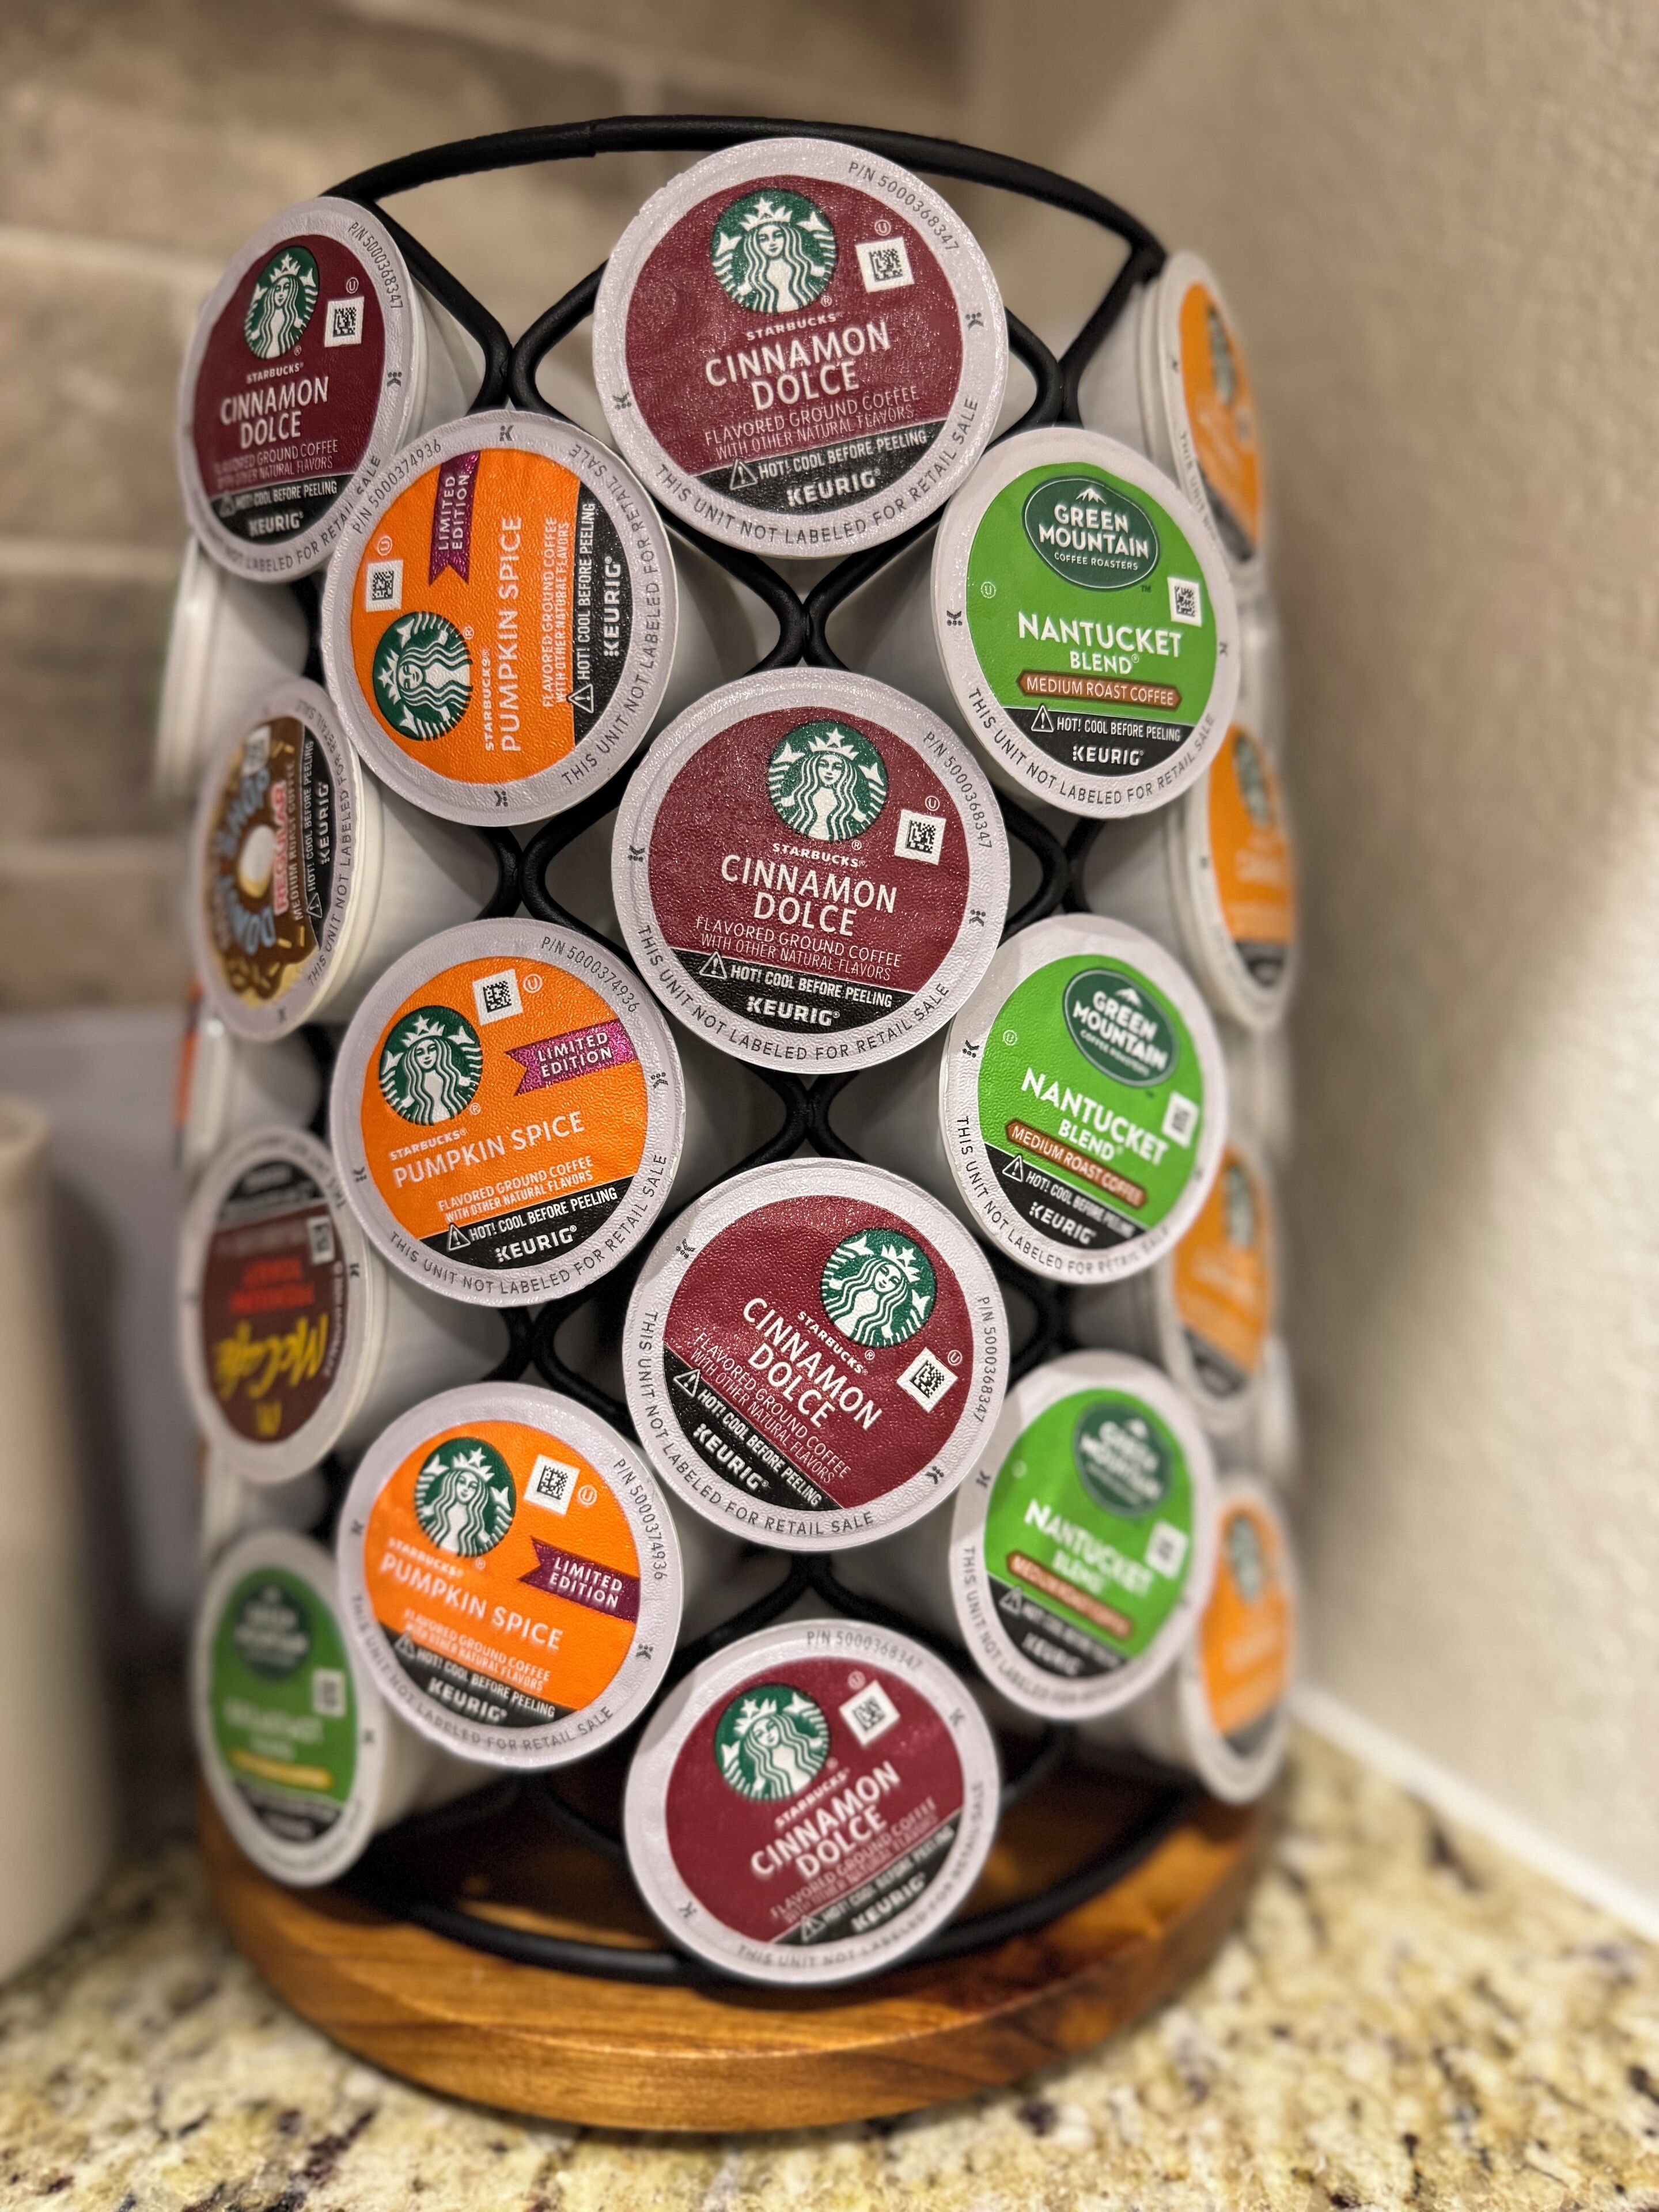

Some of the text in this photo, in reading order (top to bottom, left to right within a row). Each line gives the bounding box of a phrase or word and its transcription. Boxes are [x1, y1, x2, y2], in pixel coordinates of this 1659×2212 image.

[848, 161, 959, 252] P/N 5000368347
[347, 222, 403, 310] P/N 5000368347
[705, 321, 891, 387] CINNAMON
[752, 361, 860, 411] DOLCE
[221, 377, 329, 426] CINNAMON
[240, 412, 301, 449] DOLCE
[705, 386, 919, 447] FLAVORED GROUND COFFEE
[259, 440, 338, 465] GROUND COFFEE
[656, 397, 978, 545] THIS UNIT NOT LABELED FOR RETAIL SALE
[758, 430, 927, 480] HOT! COOL BEFORE PEELING
[274, 486, 301, 502] BEFORE
[304, 480, 337, 498] PEELING
[353, 440, 441, 533] P/N 5000374936
[438, 476, 455, 550] LIMITED
[452, 475, 470, 550] EDITION
[1054, 504, 1128, 533] GREEN
[1039, 525, 1149, 559] MOUNTAIN
[1054, 552, 1138, 570] COFFEE ROASTERS
[577, 503, 596, 680] HOT! COOL BEFORE PEELING
[498, 517, 522, 752] PUMPKIN SPICE
[1018, 610, 1181, 657] NANTUCKET
[1027, 676, 1173, 705] MEDIUM ROAST COFFEE
[968, 688, 1215, 804] THIS UNIT NOT LABELED FOR RETAIL SALE
[1056, 718, 1181, 741] HOT! COOL BEFORE PEELING
[303, 741, 313, 786] PEELING
[923, 732, 993, 849] P/N 5000368347
[722, 855, 897, 914] CINNAMON
[753, 892, 858, 937] DOLCE
[541, 936, 640, 1013] P/N 5000374936
[696, 916, 902, 968] FLAVORED GROUND COFFEE
[702, 933, 891, 981] WITH OTHER NATURAL FLAVORS
[637, 925, 949, 1060] THIS UNIT NOT LABELED FOR RETAIL SALE
[731, 964, 893, 1008] HOT! COOL BEFORE PEELING
[1093, 991, 1157, 1039] GREEN
[537, 1032, 608, 1061] LIMITED
[542, 1046, 612, 1079] EDITION
[1073, 1002, 1168, 1070] MOUNTAIN
[395, 1111, 586, 1189] PUMPKIN SPICE
[1021, 1067, 1170, 1166] NANTUCKET
[956, 1116, 988, 1196] THIS UNIT
[1012, 1125, 1143, 1206] MEDIUM ROAST COFFEE
[391, 1154, 667, 1294] THIS UNIT NOT LABELED FOR RETAIL SALE
[469, 1187, 618, 1241] HOT! COOL BEFORE PEELING
[743, 1297, 882, 1431] CINNAMON
[748, 1344, 836, 1429] DOLCE
[974, 1297, 997, 1423] P/N 5000368347
[638, 1312, 873, 1535] THIS UNIT NOT LABELED FOR RETAIL SALE
[696, 1332, 851, 1479] FLAVORED GROUND COFFEE
[698, 1391, 821, 1506] HOT! COOL BEFORE PEELING
[613, 1459, 668, 1581] P/N 5000374936
[380, 1553, 563, 1650] PUMPKIN SPICE
[550, 1571, 619, 1609] EDITION
[554, 1556, 623, 1592] LIMITED
[806, 1631, 831, 1646] P/N
[471, 1675, 555, 1718] BEFORE PEELING
[751, 1761, 901, 1877] CINNAMON
[794, 1804, 887, 1880] DOLCE
